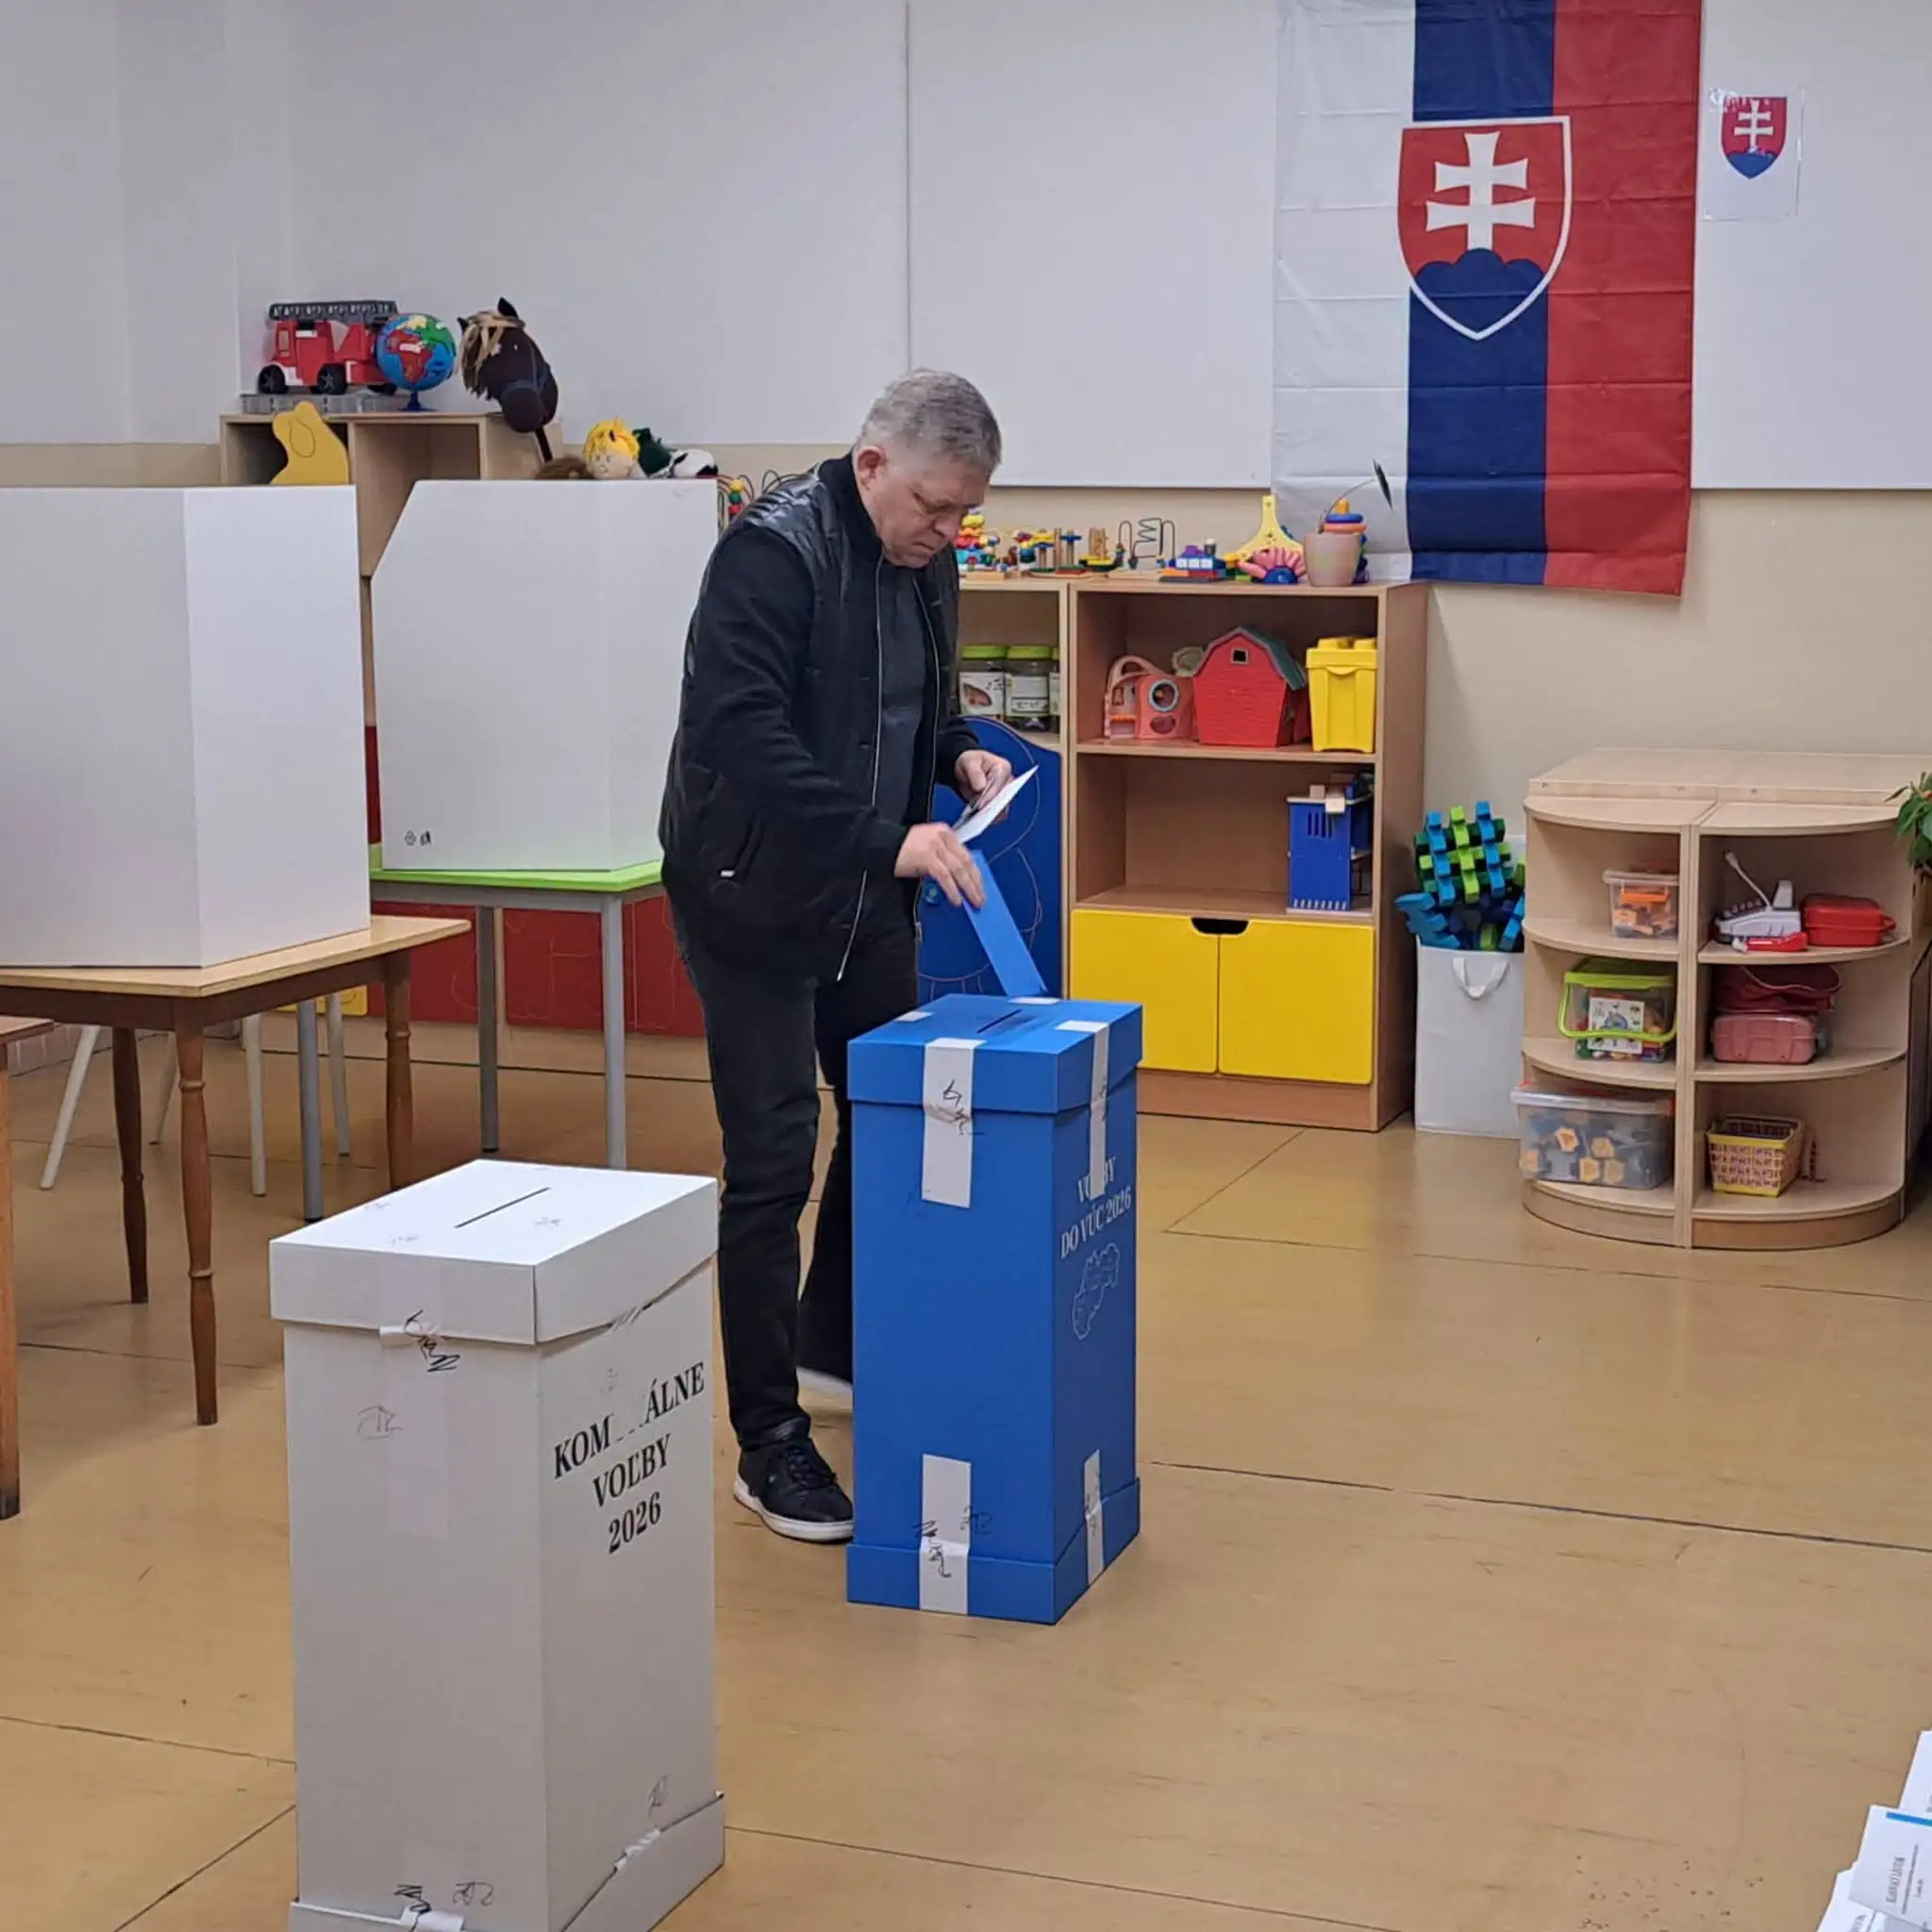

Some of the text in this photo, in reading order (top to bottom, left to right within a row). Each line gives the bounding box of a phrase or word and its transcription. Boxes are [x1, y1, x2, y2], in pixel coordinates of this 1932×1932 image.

[1078, 1156, 1116, 1203] VOBY
[1061, 1185, 1131, 1258] DO VÚC 2026
[554, 1361, 705, 1478] KOMÁLNE
[592, 1432, 672, 1508] VOĽBY
[608, 1491, 662, 1555] 2026
